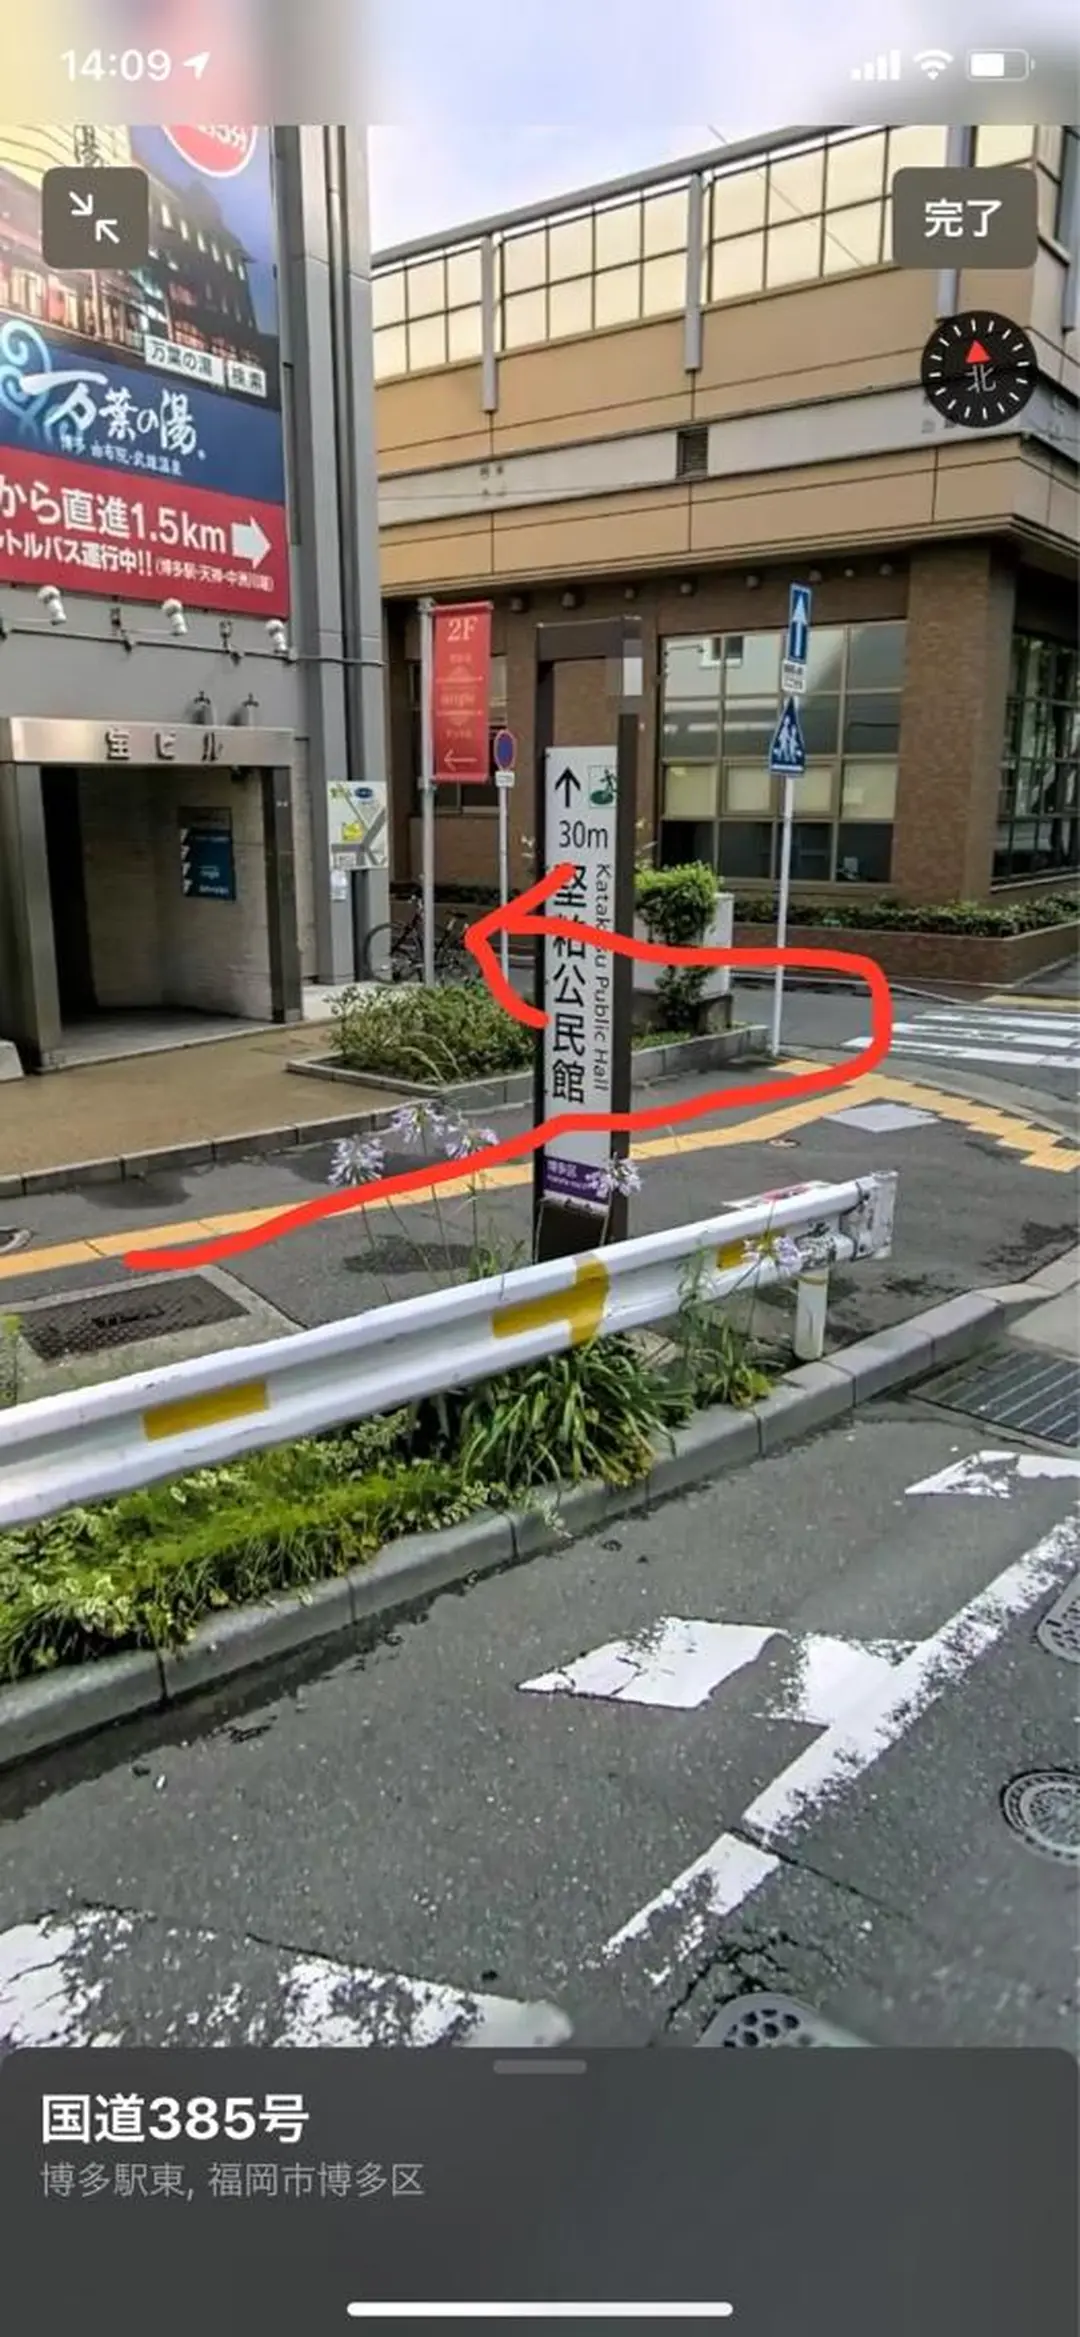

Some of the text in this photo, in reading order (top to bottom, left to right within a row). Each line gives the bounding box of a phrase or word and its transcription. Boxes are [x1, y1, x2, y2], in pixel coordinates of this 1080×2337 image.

[150, 339, 263, 390] 万葉の湯 検索
[22, 371, 199, 456] 万葉の湯
[447, 616, 479, 642] 2F
[558, 819, 608, 849] 30m
[594, 976, 609, 1042] Public
[593, 1049, 609, 1091] Hall
